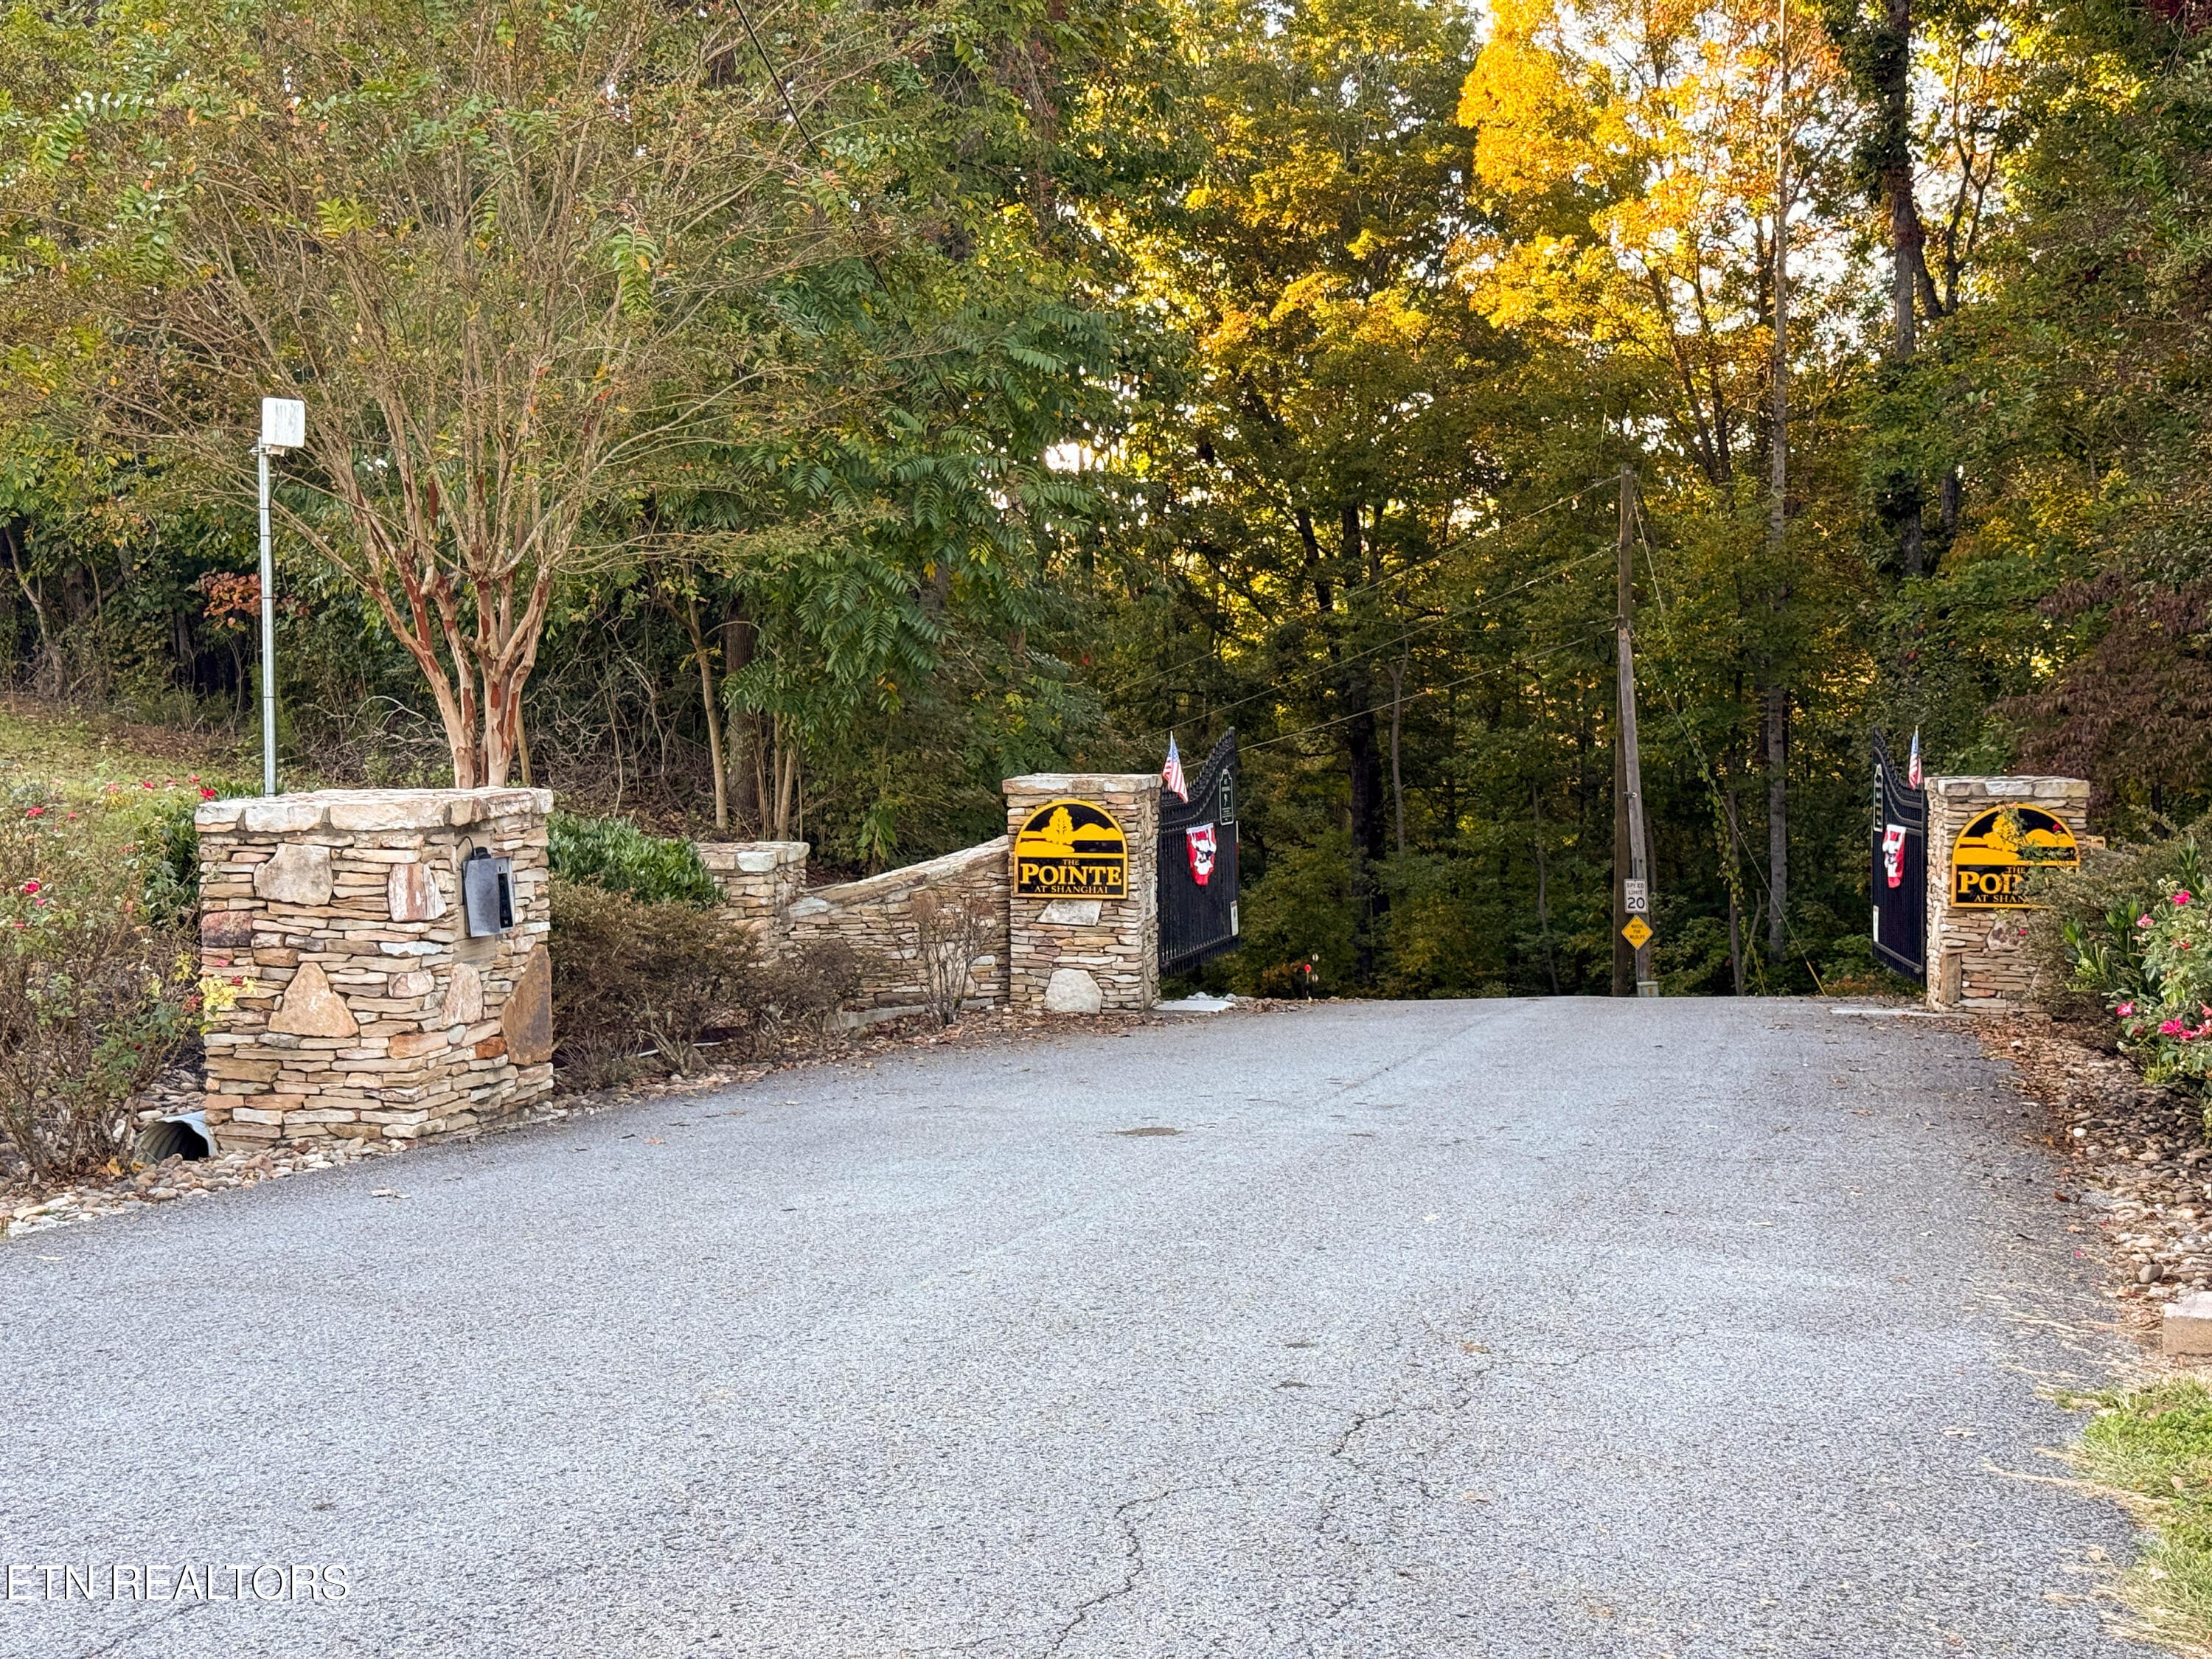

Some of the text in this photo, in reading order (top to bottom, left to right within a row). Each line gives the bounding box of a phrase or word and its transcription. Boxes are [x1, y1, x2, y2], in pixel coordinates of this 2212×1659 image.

[1020, 863, 1121, 886] POINTE
[1958, 871, 2024, 894] POI
[1051, 886, 1108, 894] SHANGHAI
[1627, 897, 1645, 908] 20
[1974, 894, 2028, 903] AT SHAN
